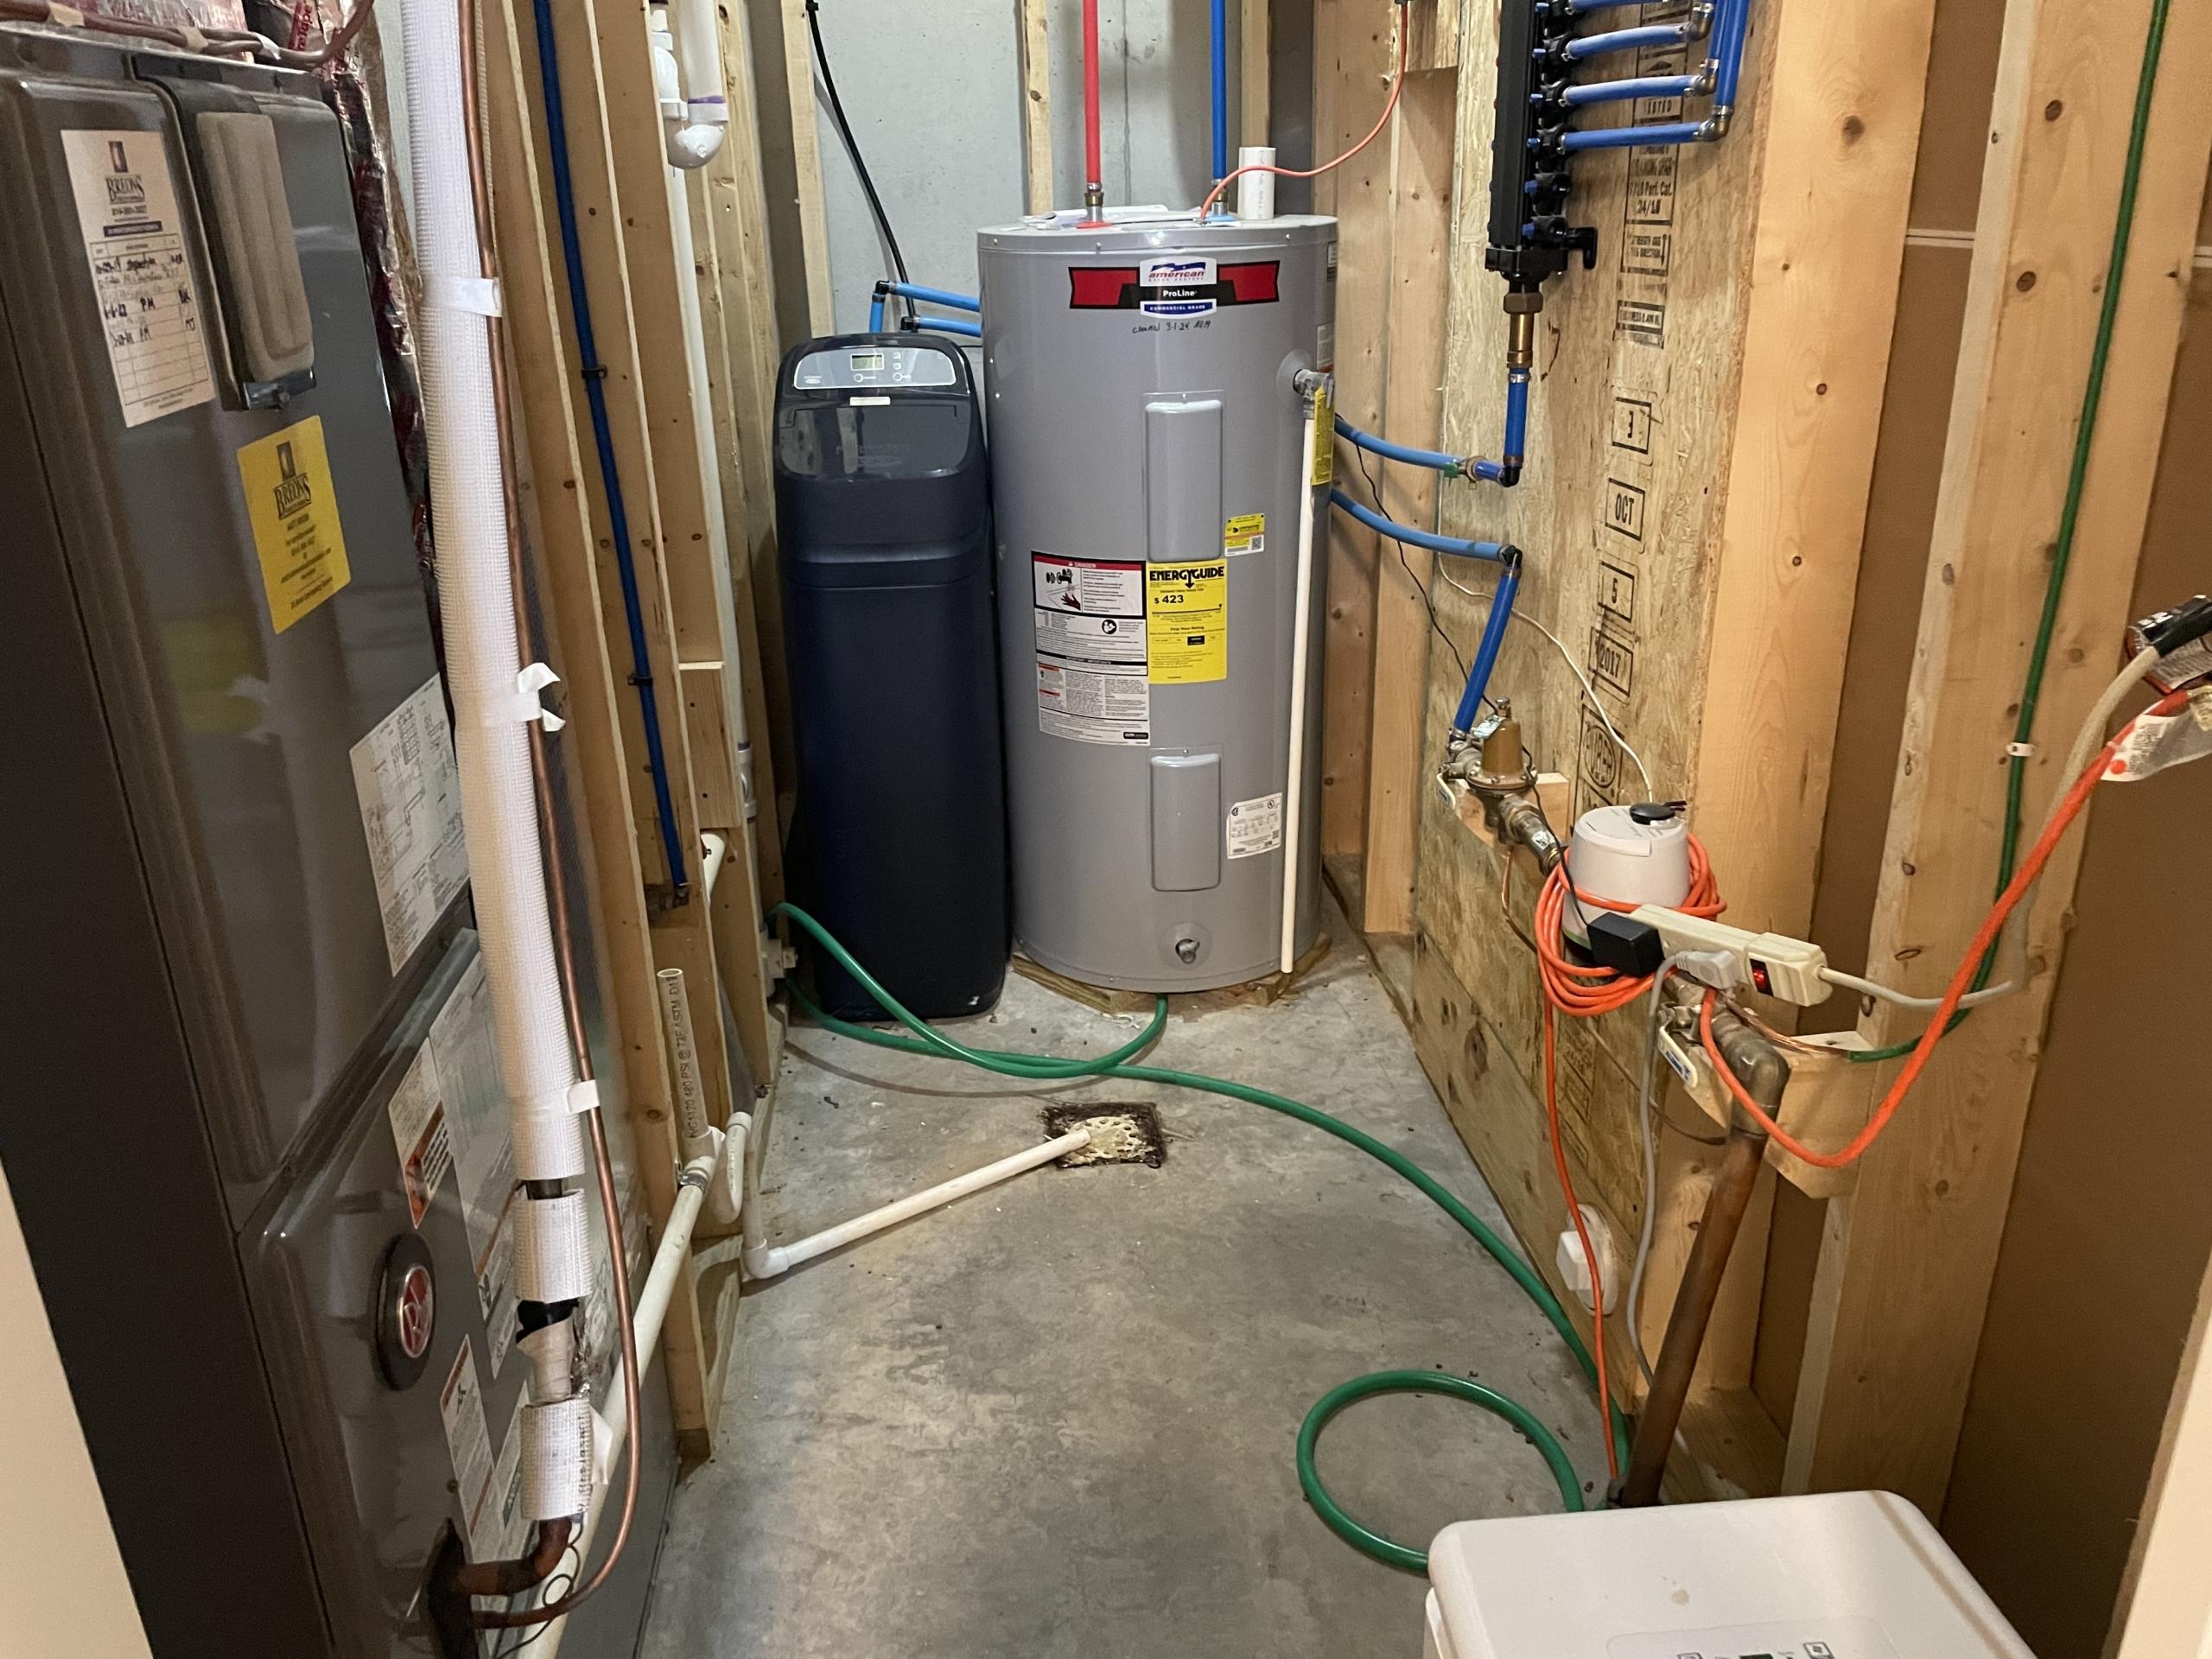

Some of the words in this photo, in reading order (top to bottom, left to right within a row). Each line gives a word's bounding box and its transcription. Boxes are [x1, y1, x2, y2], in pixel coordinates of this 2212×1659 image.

[1615, 493, 1635, 525] OCT
[1162, 594, 1184, 603] 423
[1611, 577, 1618, 604] 5
[1599, 643, 1622, 678] 2017
[671, 1000, 683, 1027] ASTM
[680, 1061, 691, 1079] PSI
